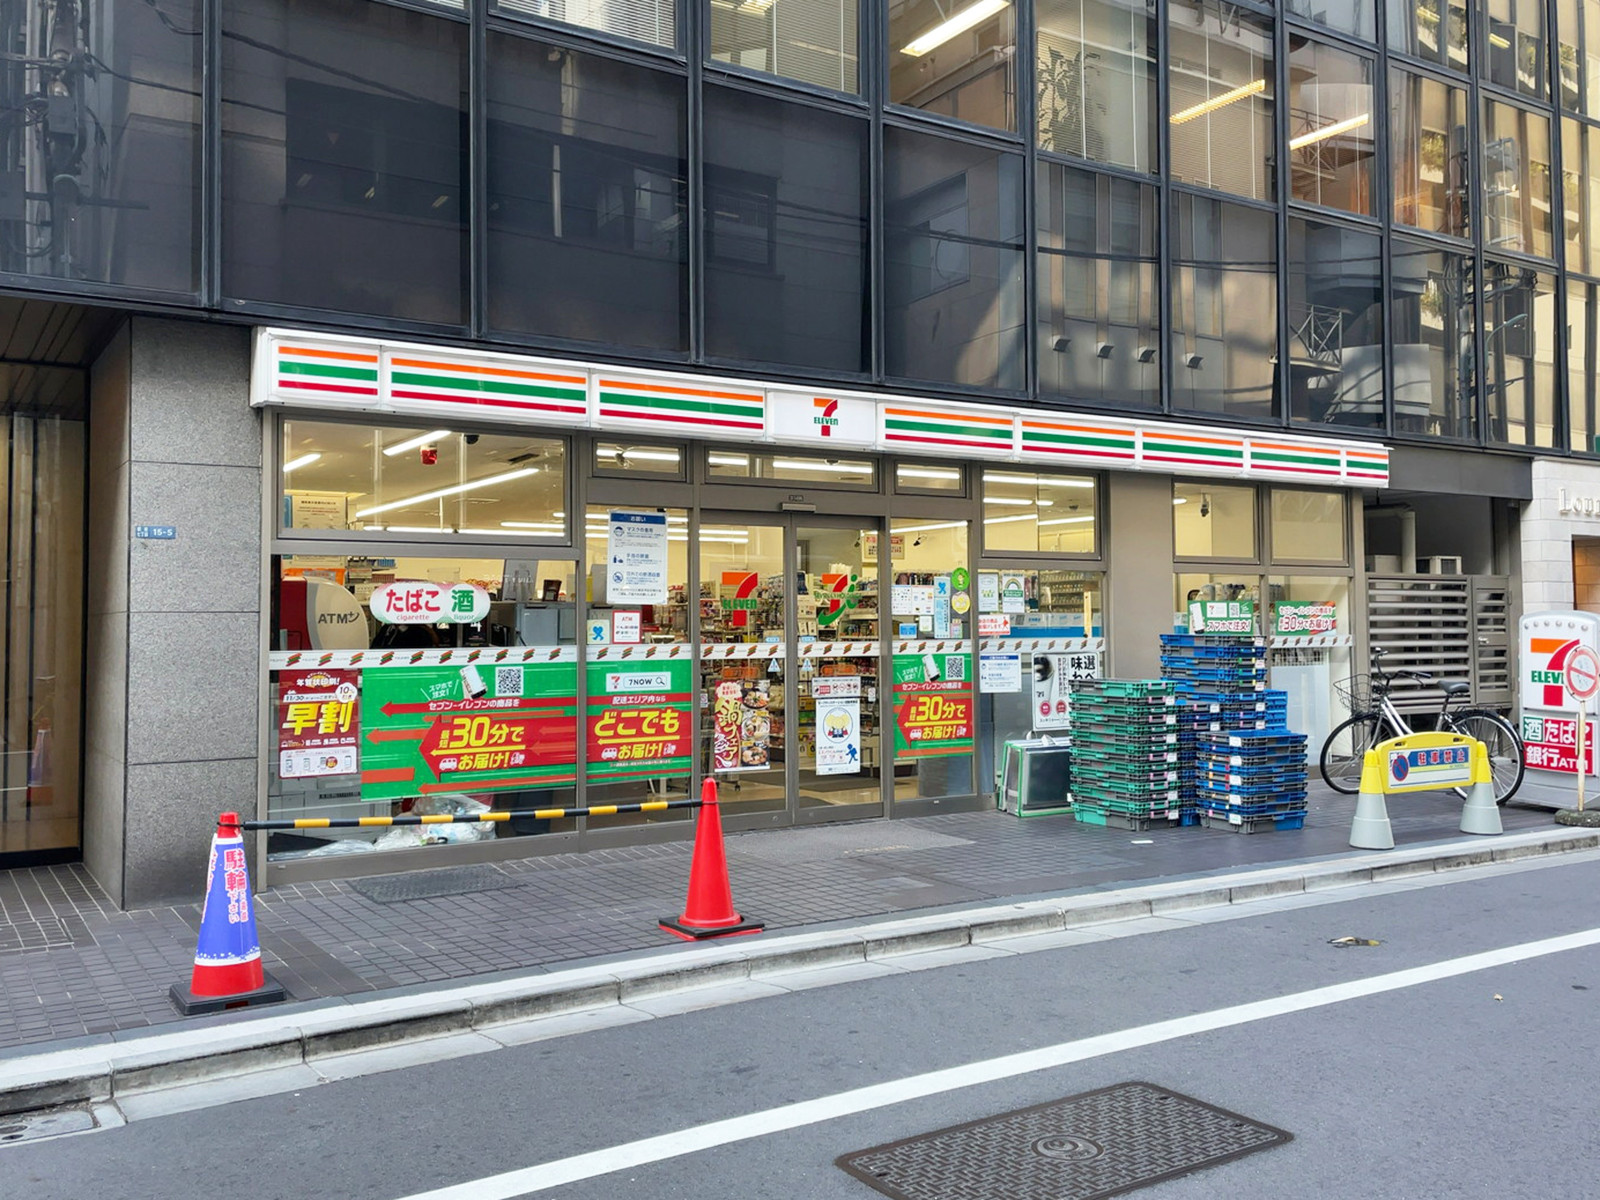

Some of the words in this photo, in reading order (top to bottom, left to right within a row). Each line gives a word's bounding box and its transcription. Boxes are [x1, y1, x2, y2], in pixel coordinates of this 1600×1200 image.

[152, 528, 173, 536] 15-5
[386, 589, 441, 613] たばこ
[451, 589, 475, 612] 酒
[318, 613, 348, 624] ATM
[396, 613, 430, 621] cigarette
[453, 613, 475, 621] liquor
[1531, 670, 1564, 684] ELEV
[282, 701, 355, 735] 早割
[594, 709, 680, 737] どこでも
[922, 726, 956, 739] お届け!
[1524, 718, 1543, 742] 酒
[618, 743, 664, 760] お届け!
[1417, 748, 1466, 765] 駐車禁止
[458, 752, 509, 771] お届け!
[225, 849, 246, 891] 駐輪
